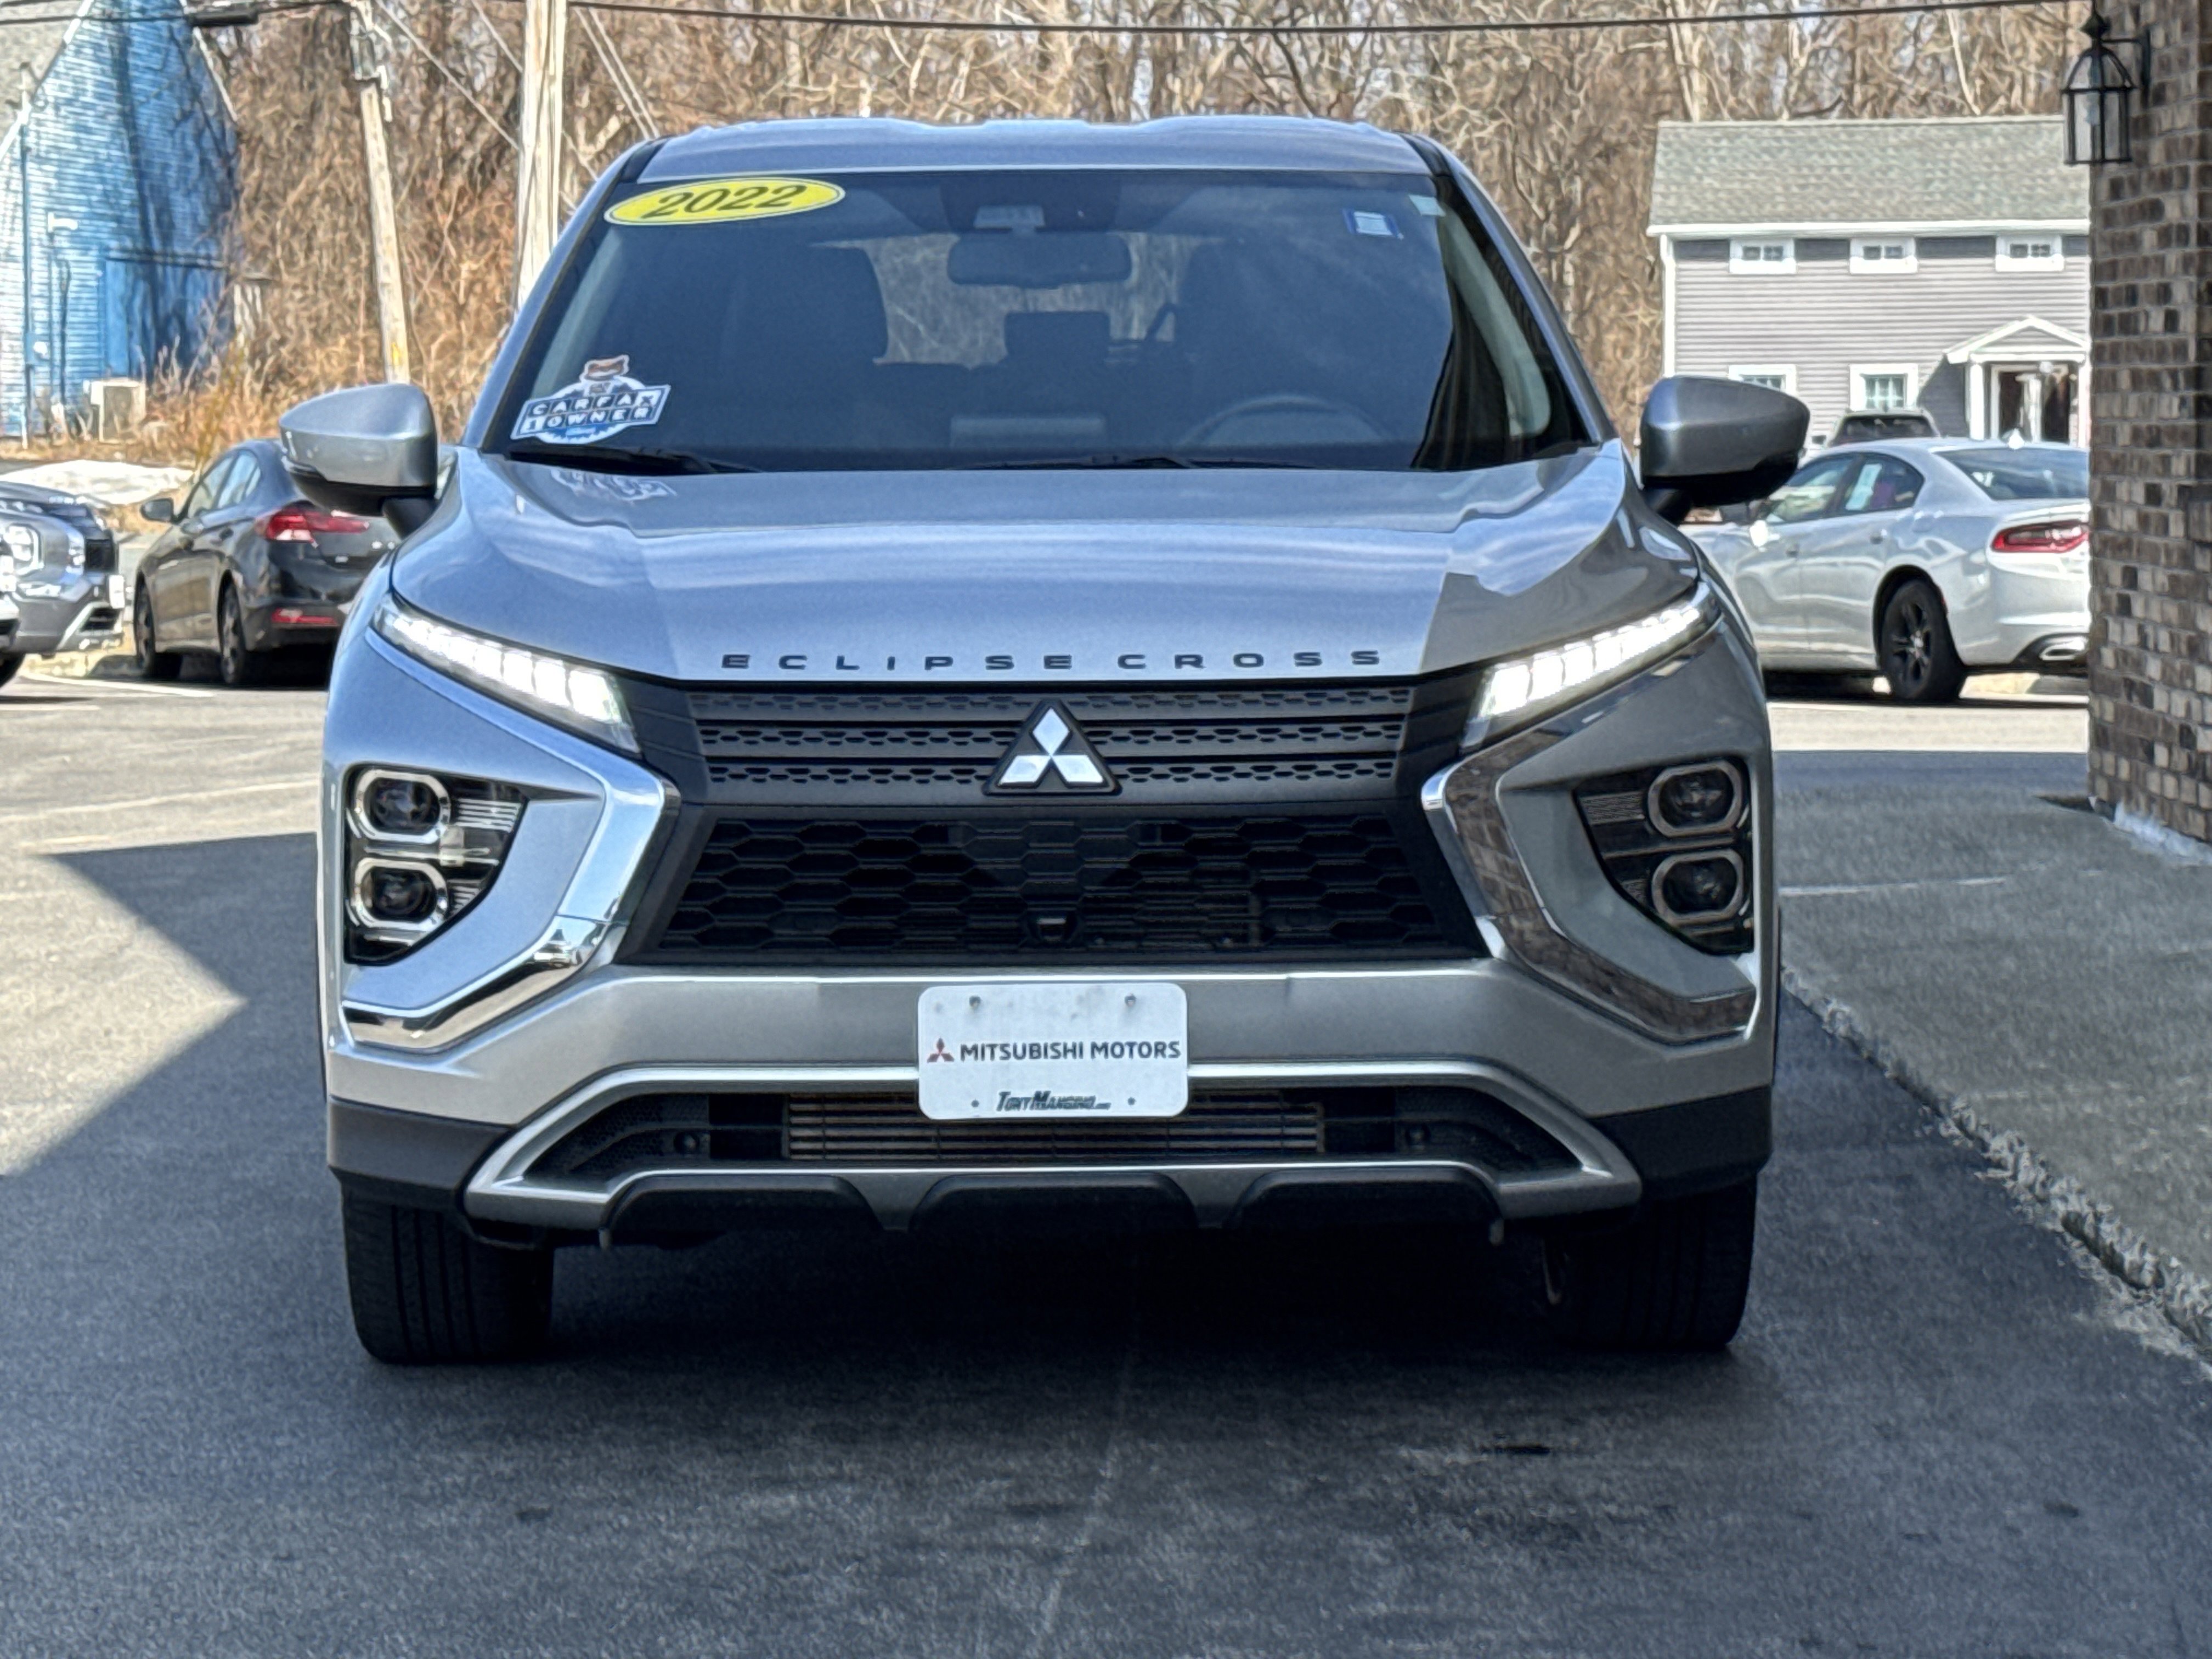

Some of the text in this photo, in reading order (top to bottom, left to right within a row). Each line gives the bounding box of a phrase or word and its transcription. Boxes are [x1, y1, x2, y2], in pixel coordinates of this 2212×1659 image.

[641, 185, 808, 219] 2022
[532, 392, 654, 415] CARFAX
[547, 407, 650, 429] OWNER
[721, 650, 1380, 670] ECLIPSE CROSS
[960, 1041, 1181, 1061] MITSUBISHI MOTORS
